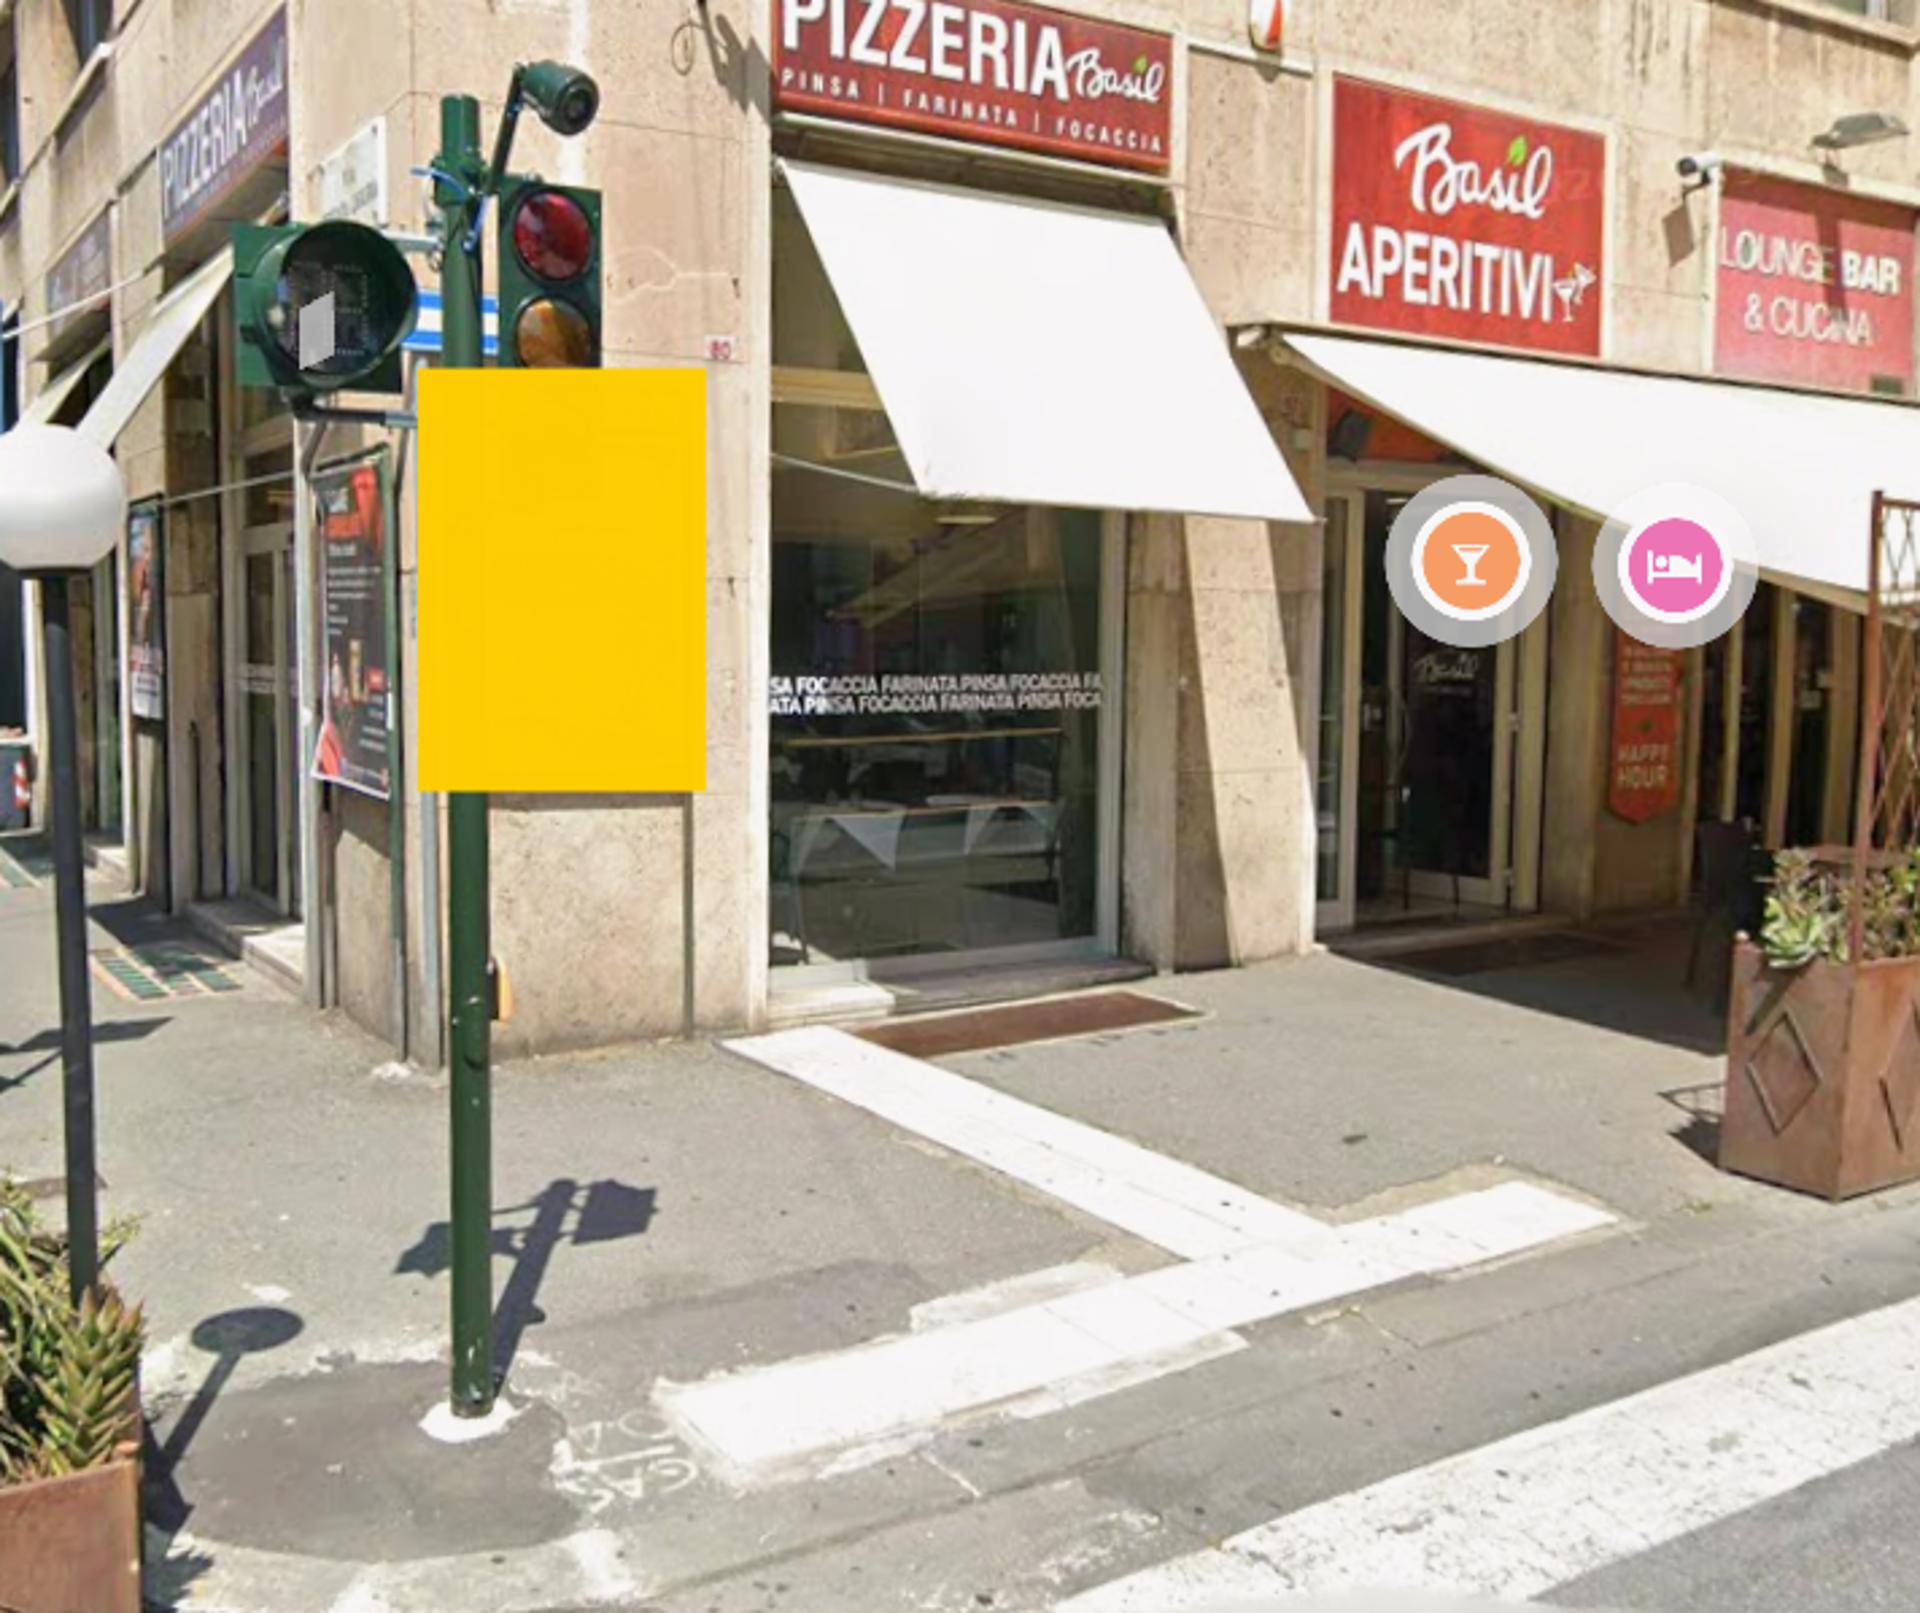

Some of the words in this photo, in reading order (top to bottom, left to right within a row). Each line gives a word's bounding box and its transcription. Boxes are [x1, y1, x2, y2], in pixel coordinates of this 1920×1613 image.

[782, 0, 1070, 102] PIZZERIA
[1064, 47, 1165, 104] Basil
[163, 68, 247, 221] PIZZERIA
[781, 67, 860, 100] PINSA
[902, 88, 1018, 127] FARINATA
[1055, 116, 1161, 154] FOCACCIA
[1394, 121, 1553, 220] Basil
[1336, 219, 1554, 323] APERITIVI
[1719, 225, 1835, 287] LOUNGE
[1840, 249, 1902, 296] BAR
[1743, 292, 1764, 334] &
[1770, 296, 1875, 348] CUCINA
[796, 675, 879, 695] FOCACCIA
[881, 674, 958, 694] FARINATA
[960, 673, 1007, 692] PINSA
[1009, 673, 1082, 691] FOCACCIA
[803, 694, 856, 714] PINSA
[858, 693, 938, 713] FOCACCIA
[940, 692, 1015, 712] FARINATA
[1017, 692, 1063, 711] PINSA
[1616, 764, 1666, 789] HOUR
[1618, 744, 1668, 763] HAPPY
